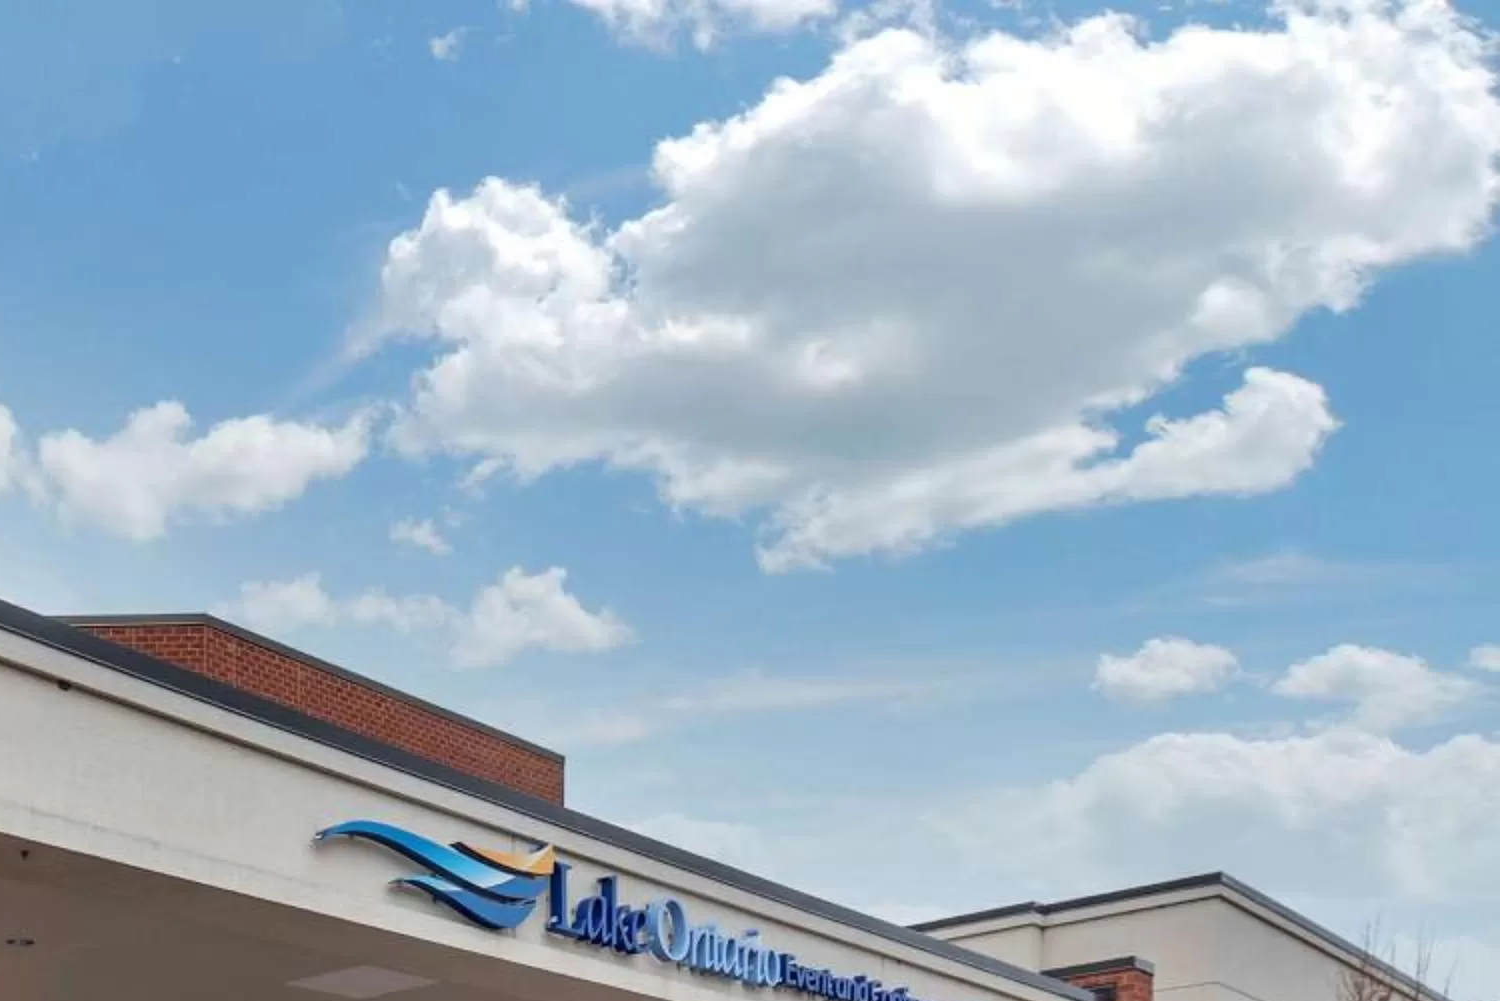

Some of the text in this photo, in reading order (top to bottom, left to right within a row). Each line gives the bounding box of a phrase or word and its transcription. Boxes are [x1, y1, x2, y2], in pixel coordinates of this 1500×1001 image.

[546, 861, 653, 954] Lake
[649, 897, 787, 988] Ontario
[780, 954, 834, 998] Event
